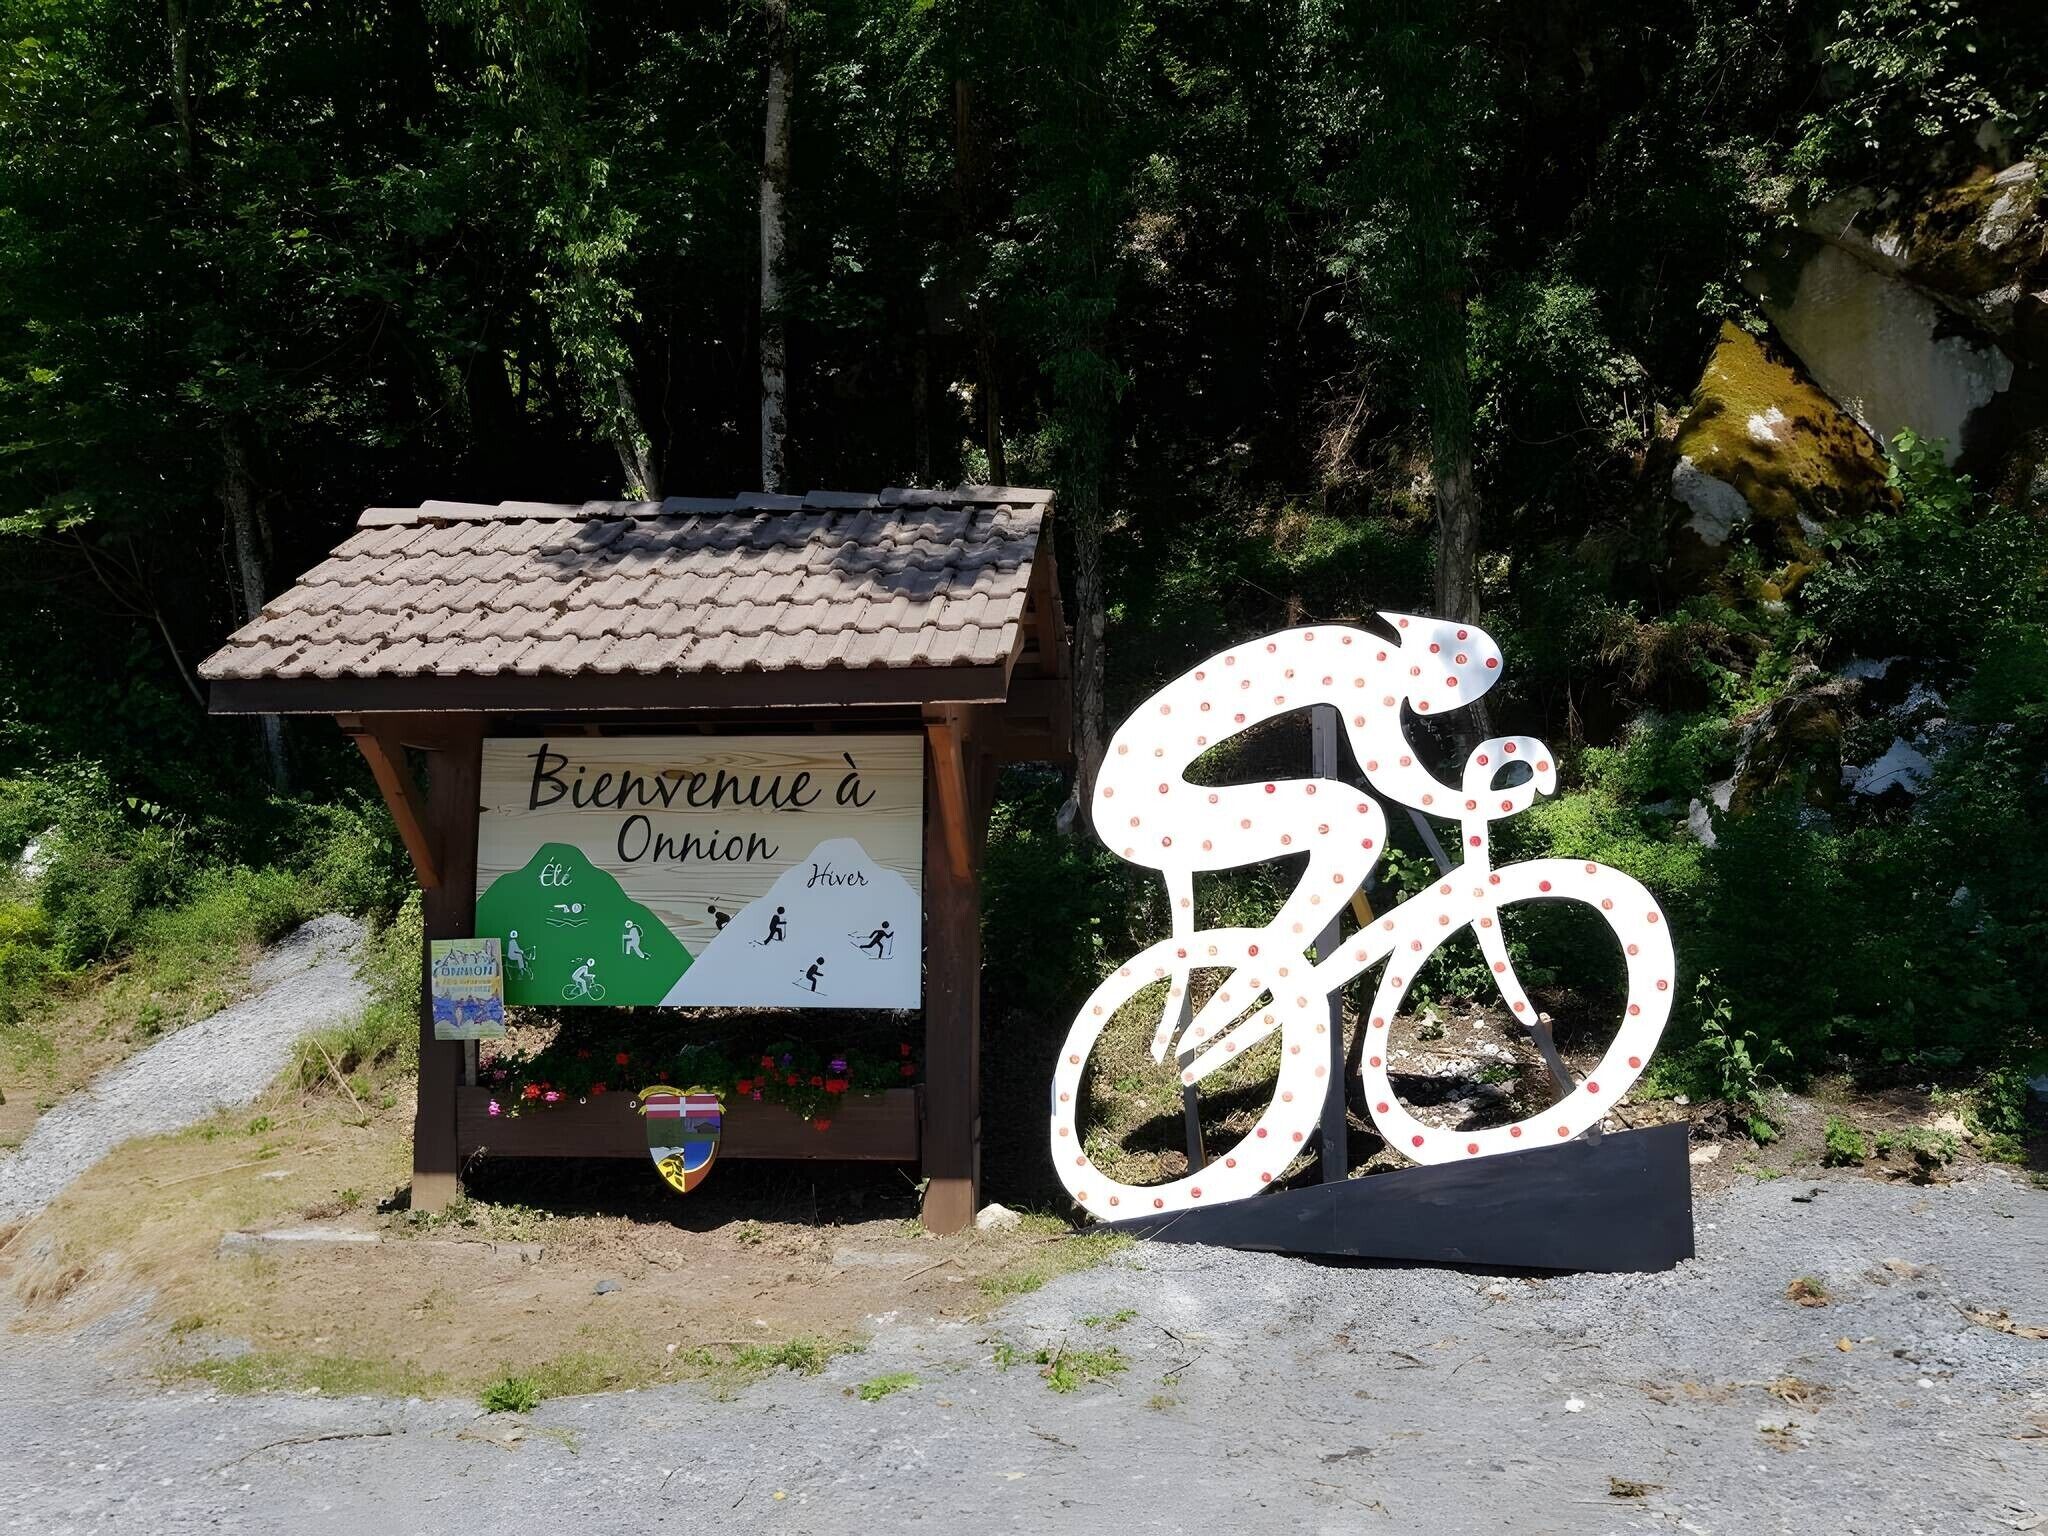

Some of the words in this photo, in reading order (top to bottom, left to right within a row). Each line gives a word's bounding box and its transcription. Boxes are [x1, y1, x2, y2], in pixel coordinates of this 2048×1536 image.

[527, 743, 822, 811] Bienvenue
[836, 752, 876, 808] à
[617, 815, 779, 863] Onnion
[540, 857, 573, 887] Été
[807, 862, 869, 888] Hiver
